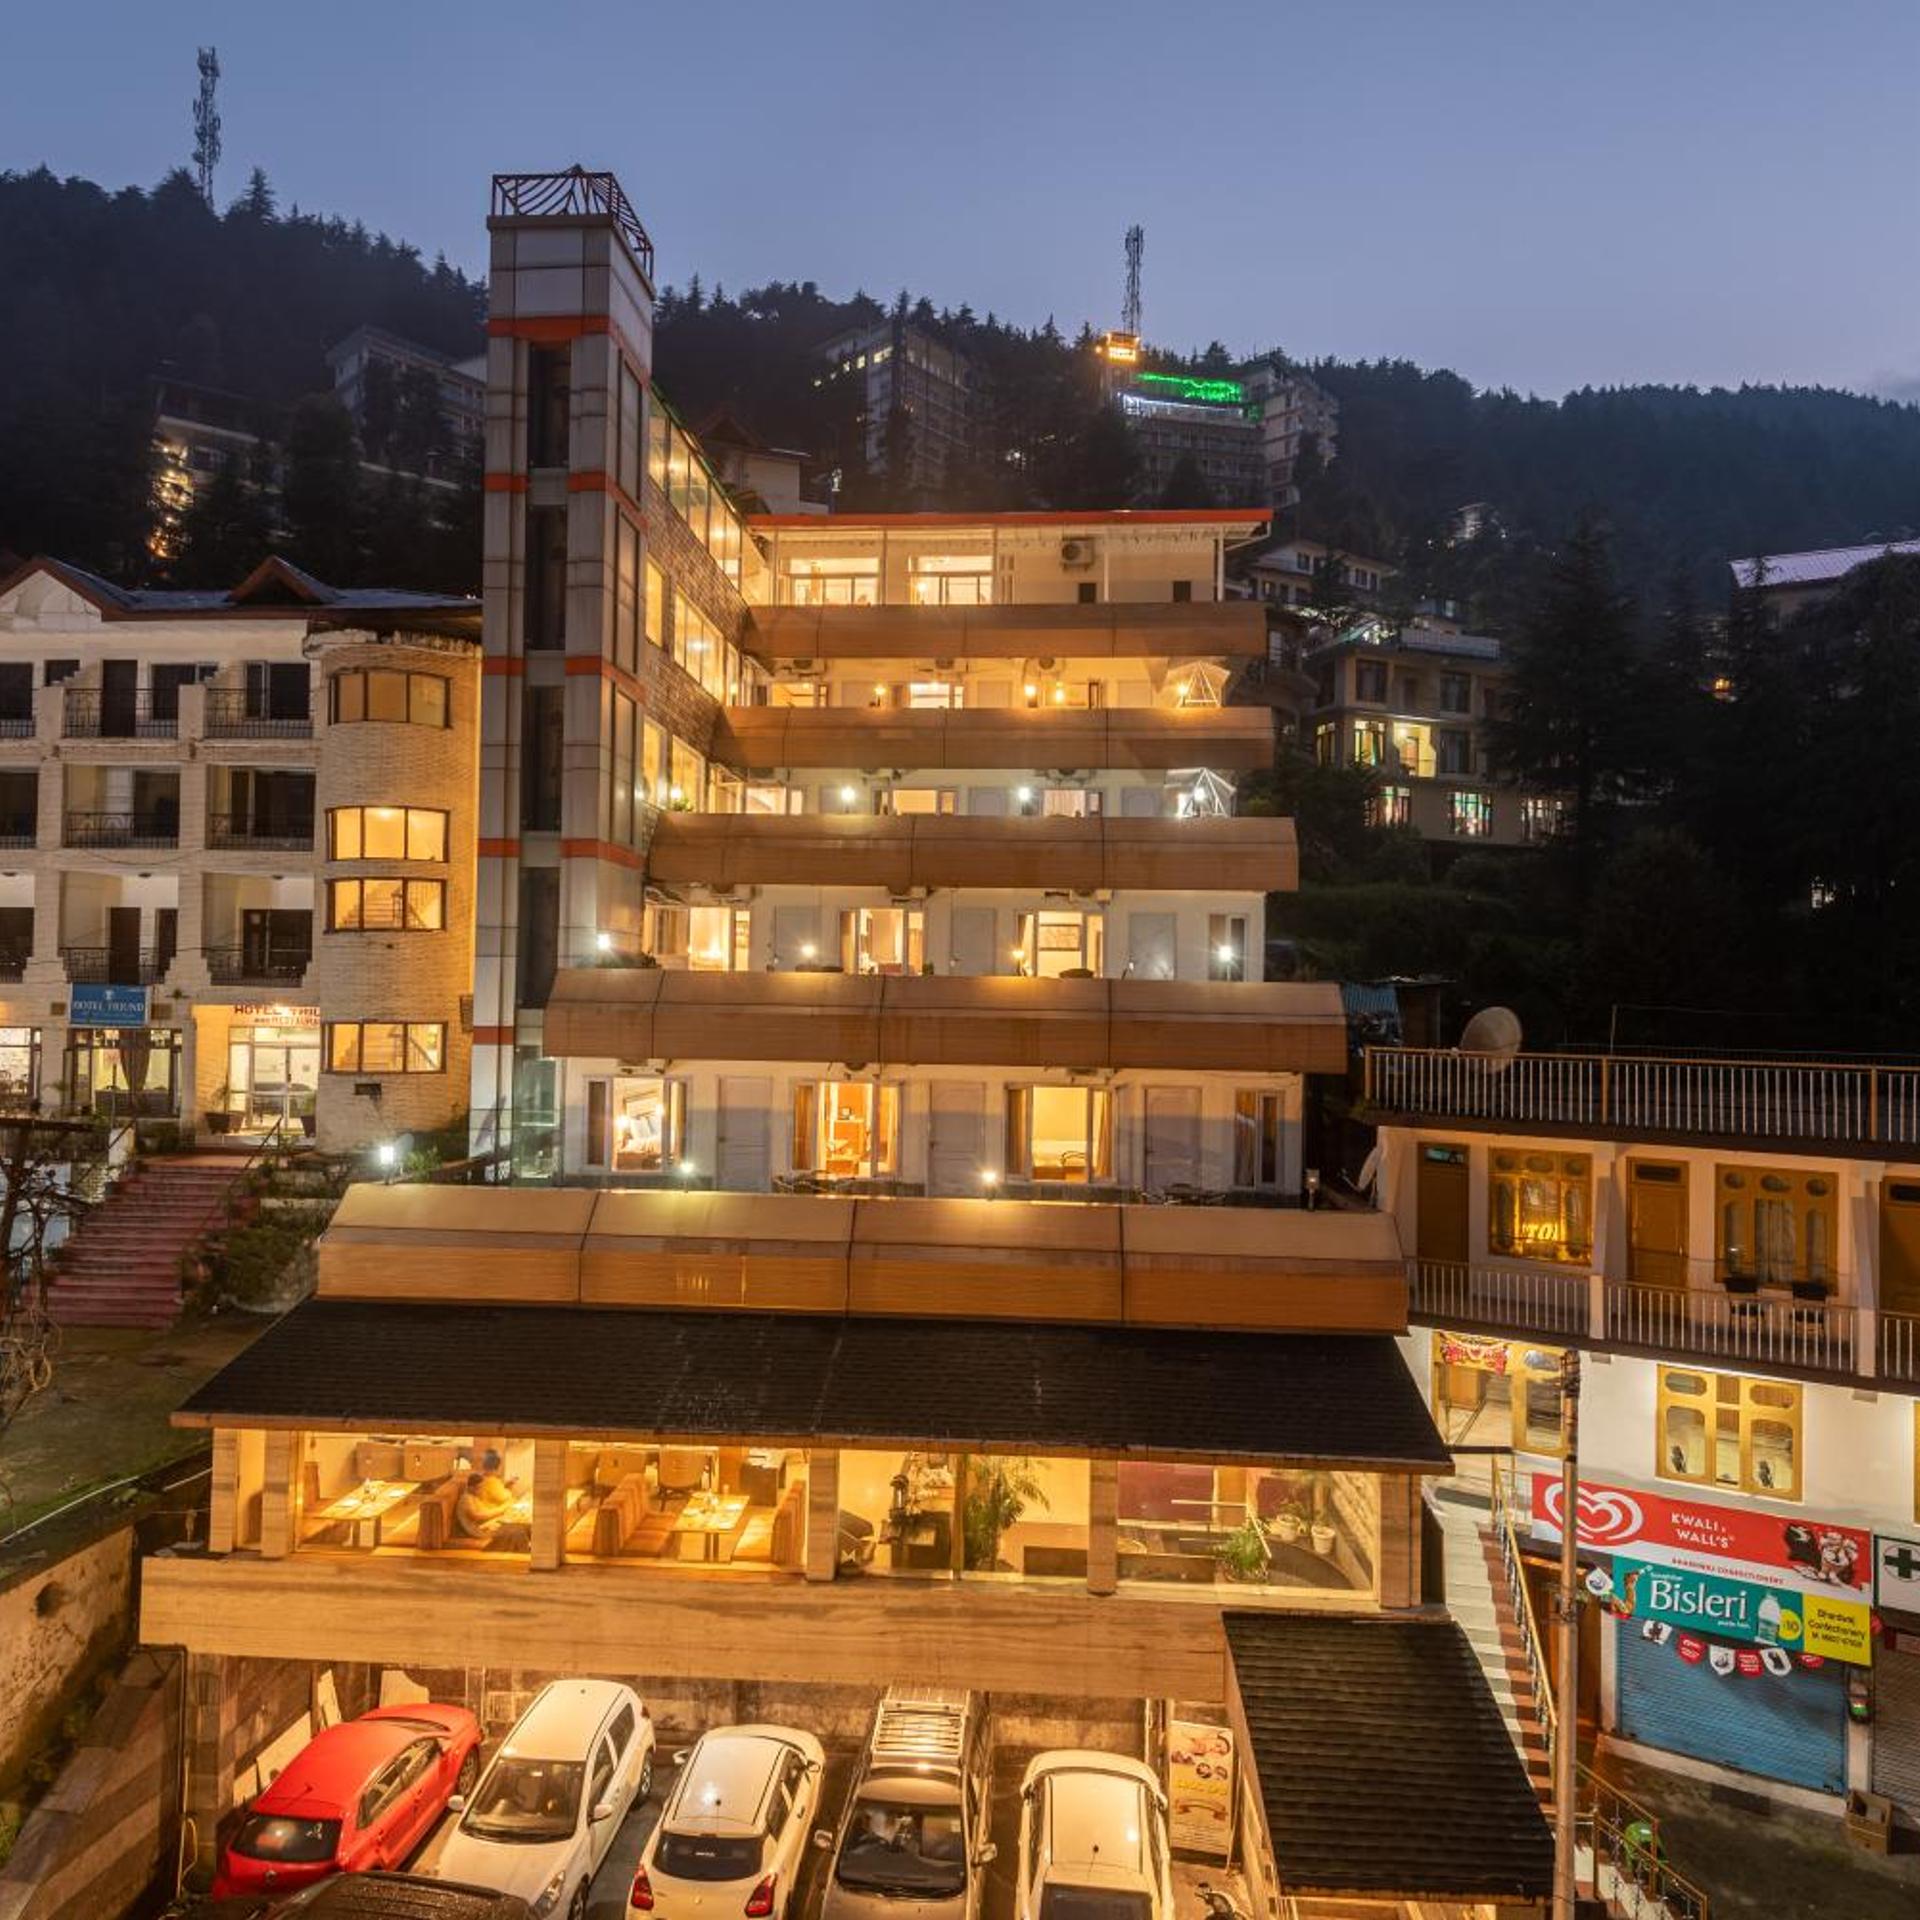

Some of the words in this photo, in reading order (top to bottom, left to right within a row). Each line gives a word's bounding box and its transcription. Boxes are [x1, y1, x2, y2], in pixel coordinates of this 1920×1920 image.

[233, 1004, 283, 1015] HOTEL
[1675, 1528, 1729, 1549] WALL'S
[1650, 1580, 1748, 1620] Bisleri
